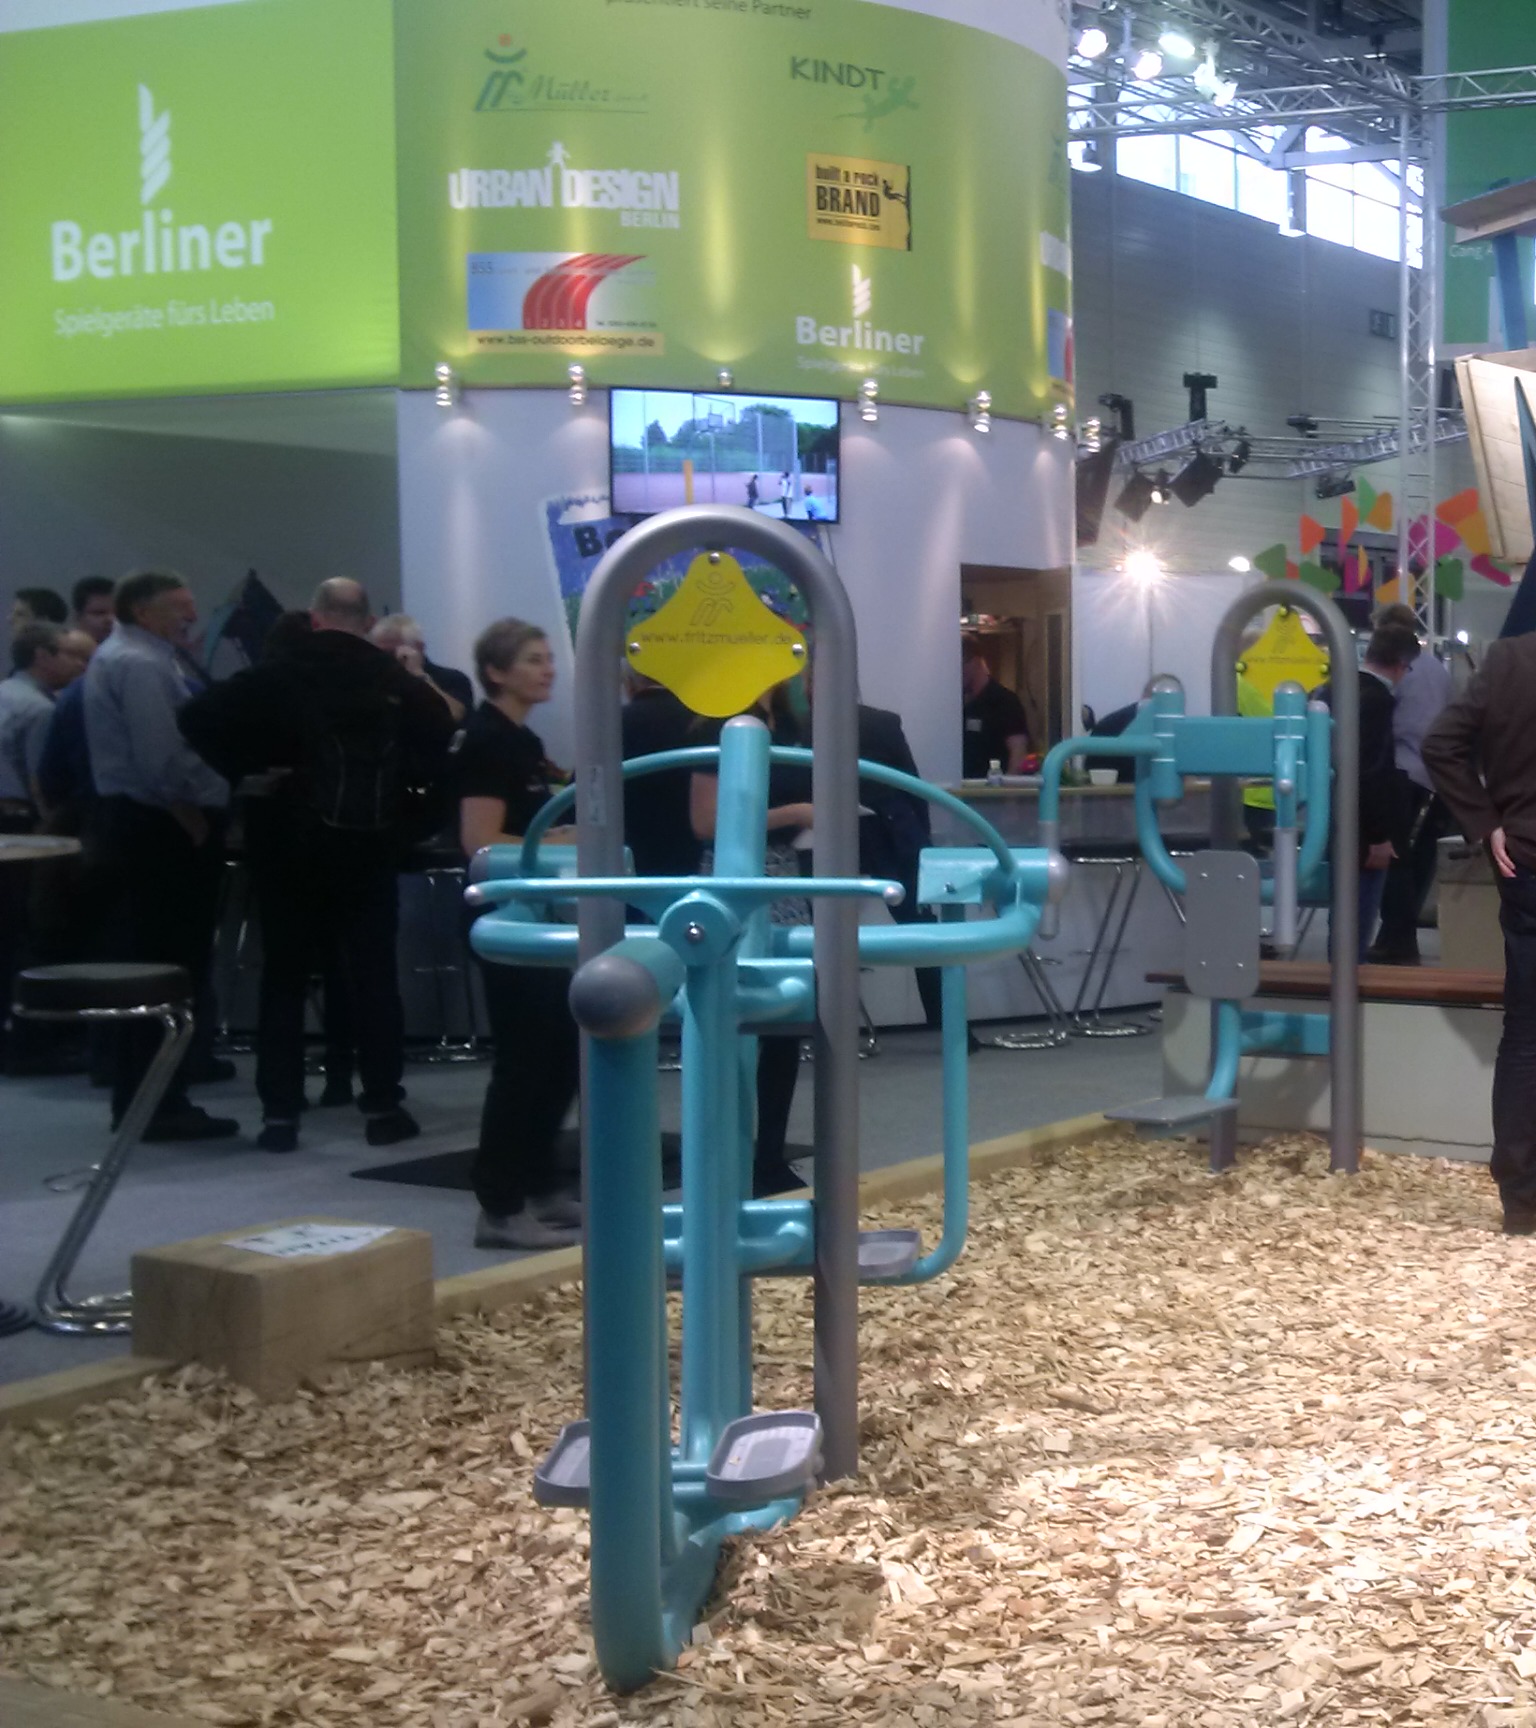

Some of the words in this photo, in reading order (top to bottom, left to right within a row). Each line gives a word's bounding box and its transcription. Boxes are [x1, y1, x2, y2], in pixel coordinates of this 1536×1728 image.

[790, 55, 886, 91] KINDT
[448, 166, 554, 209] URBAN
[560, 168, 680, 211] DESIGN
[816, 185, 880, 217] BRAND
[620, 211, 681, 229] BERLIN
[50, 208, 273, 283] Berliner
[54, 307, 165, 338] Spielgeräte
[209, 297, 276, 324] Leben
[795, 315, 925, 356] Berliner
[640, 630, 792, 646] www.fritzmueller.de
